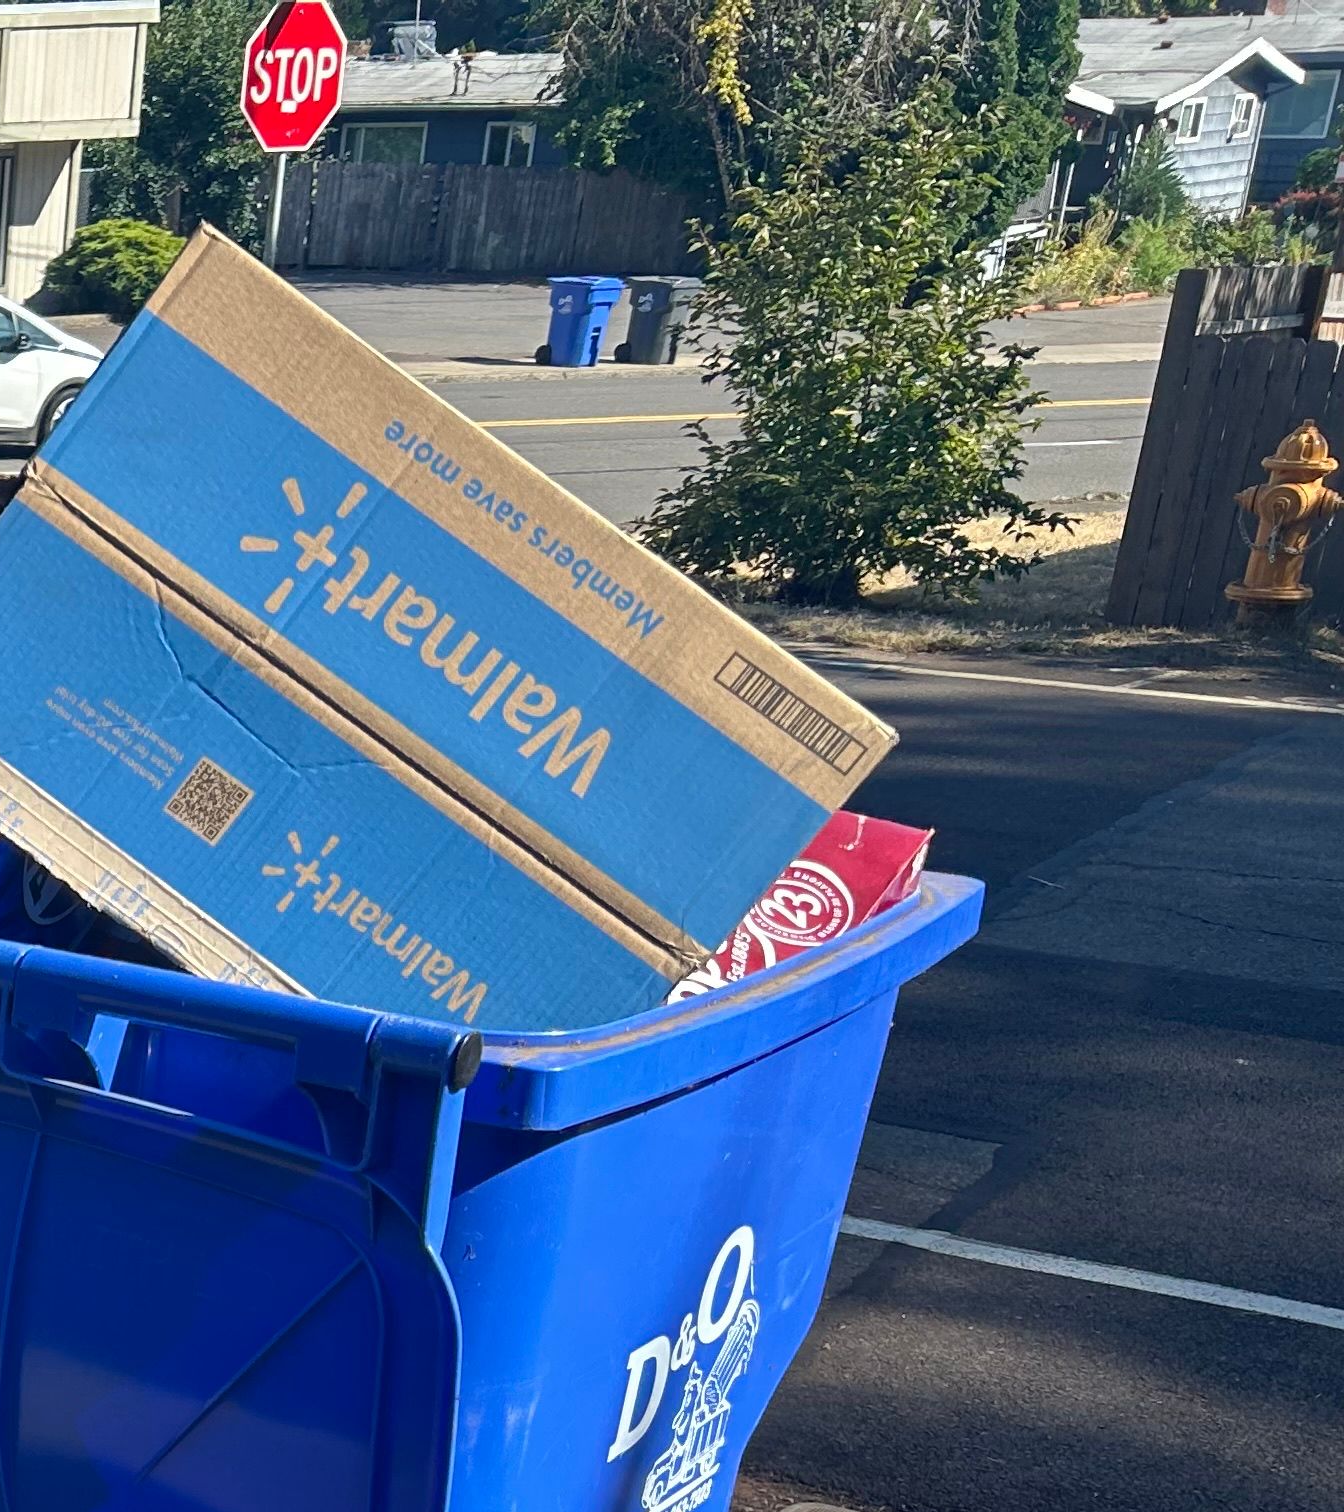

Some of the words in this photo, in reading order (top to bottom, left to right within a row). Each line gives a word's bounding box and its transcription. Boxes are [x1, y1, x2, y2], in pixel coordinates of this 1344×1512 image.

[250, 48, 339, 104] STOP
[384, 419, 462, 487] more
[464, 476, 529, 532] save
[530, 523, 665, 640] Members
[761, 888, 823, 929] 23
[608, 1225, 754, 1463] D&O
